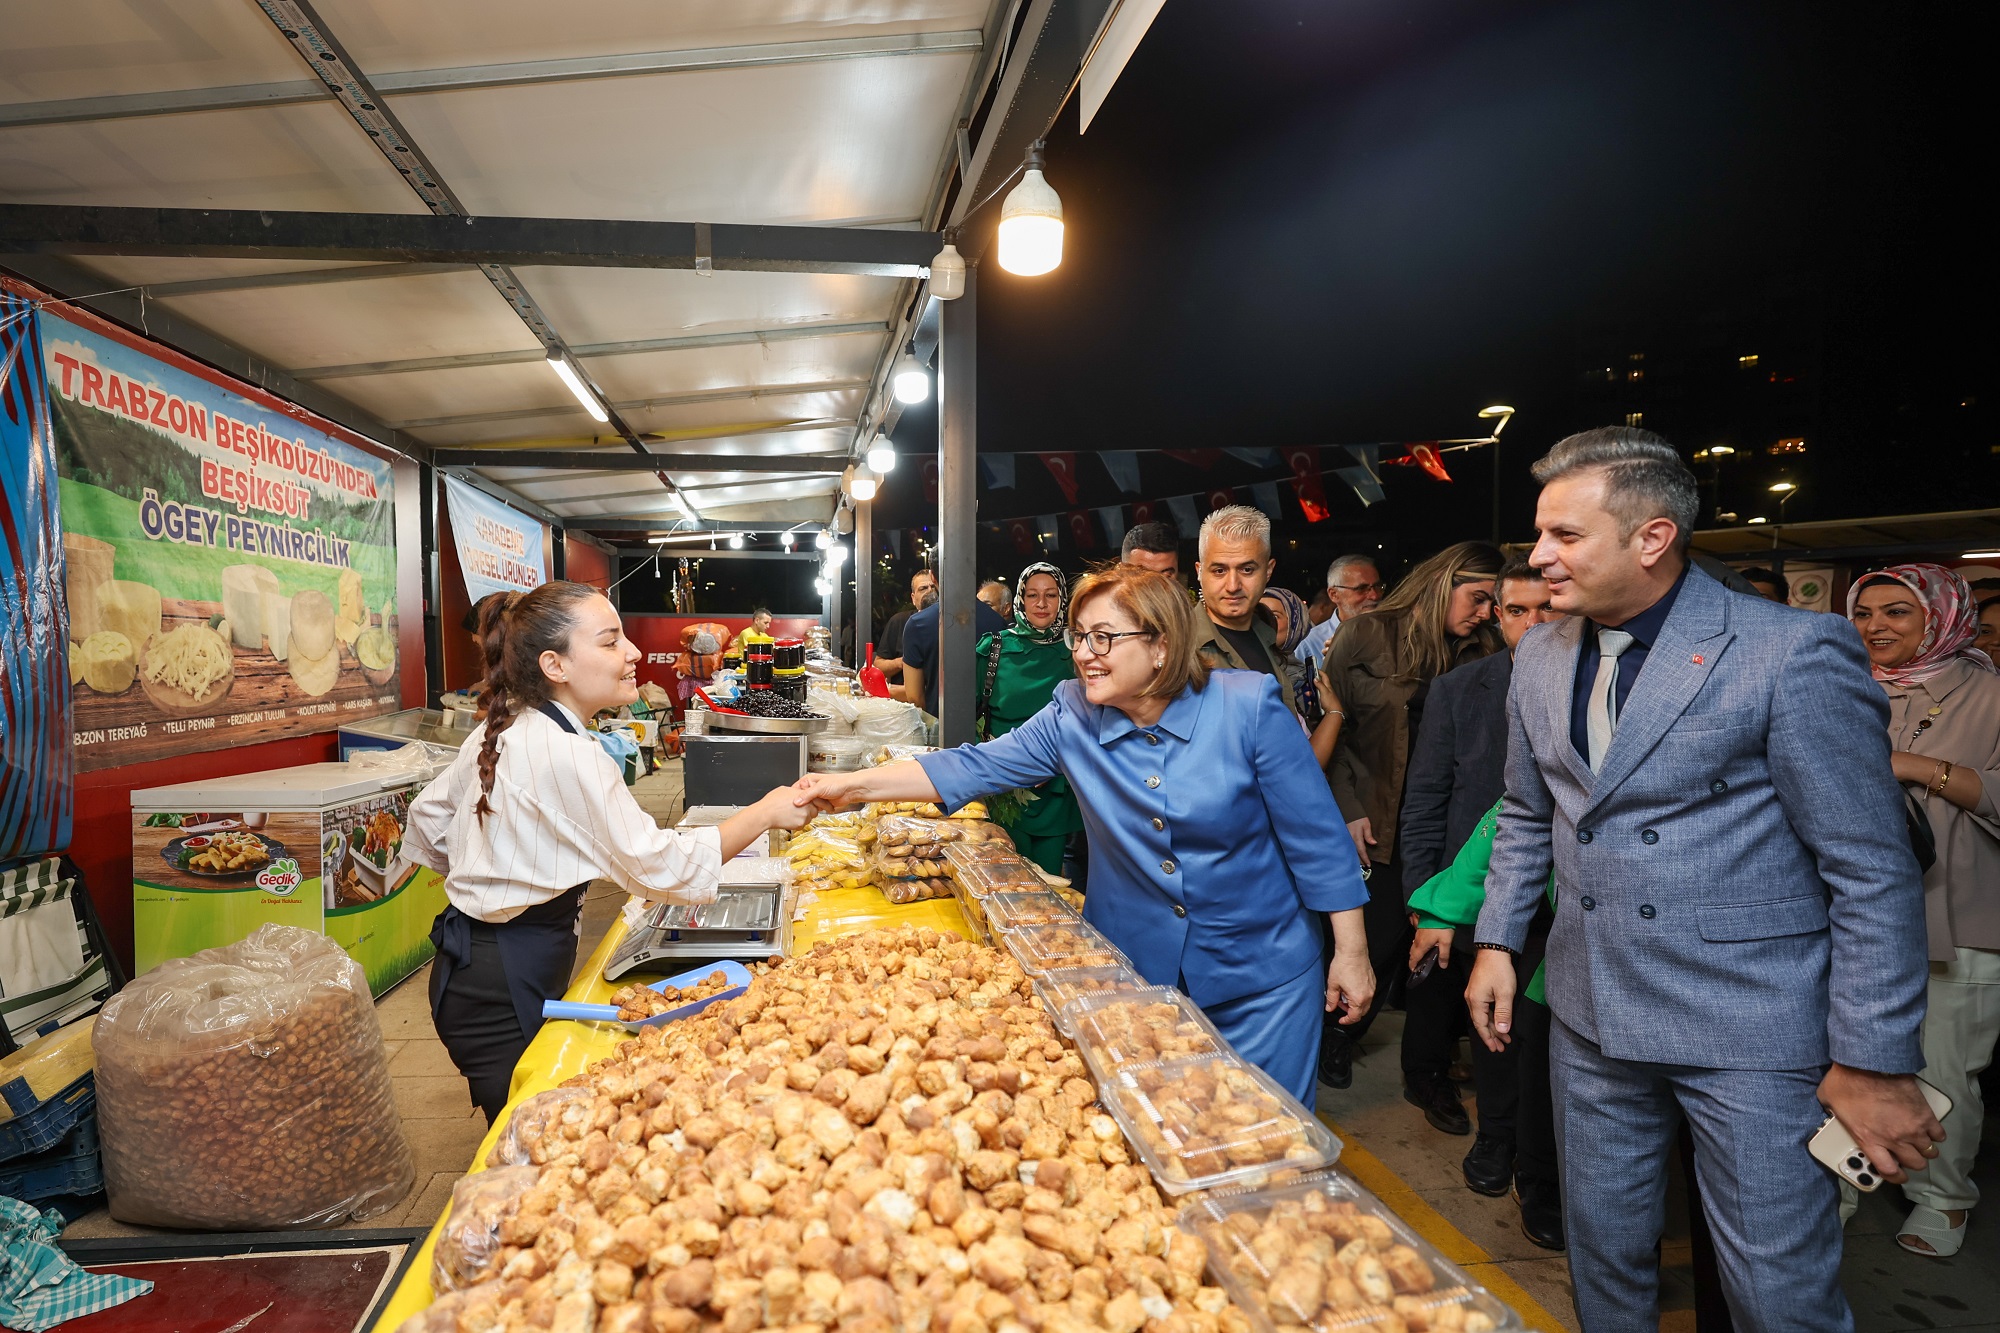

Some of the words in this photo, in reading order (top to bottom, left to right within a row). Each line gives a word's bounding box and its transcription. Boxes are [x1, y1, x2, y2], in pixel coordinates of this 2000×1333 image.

[54, 352, 207, 442] TRABZON
[203, 461, 309, 518] BEŞİKSÜT
[141, 492, 219, 545] ÖGEY
[226, 520, 350, 567] PEYNİRCİLİK
[264, 710, 286, 720] TULUM
[299, 705, 318, 716] KOLOT
[73, 730, 105, 746] BZON
[108, 723, 147, 741] TEREYAĞ
[259, 873, 296, 886] Gedik
